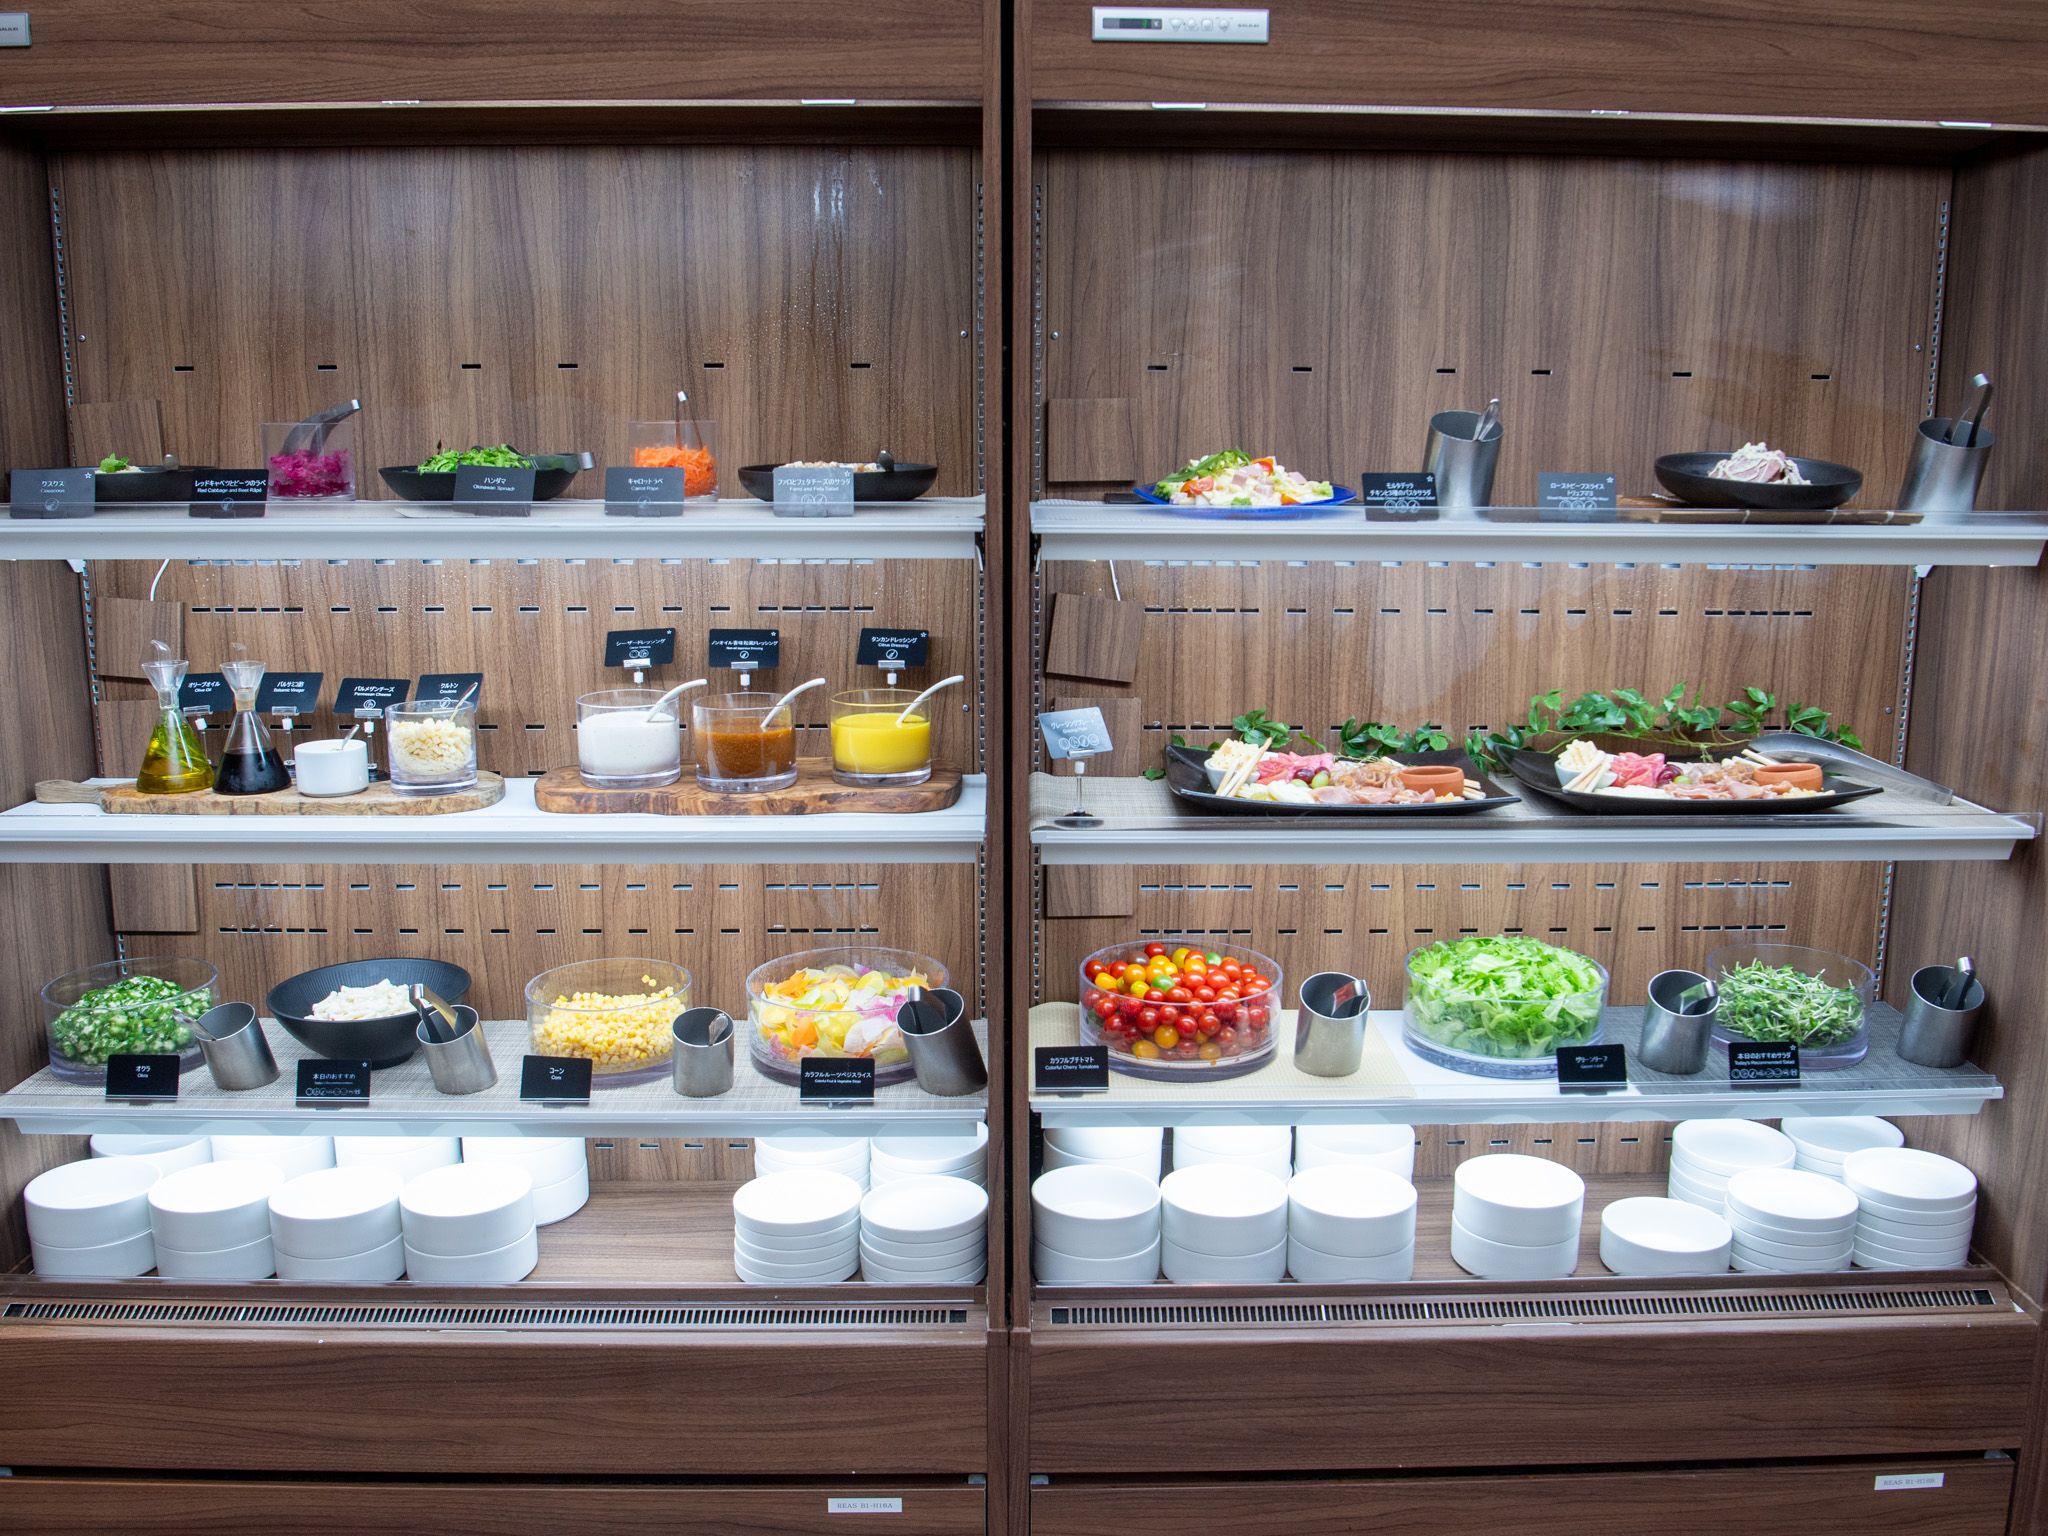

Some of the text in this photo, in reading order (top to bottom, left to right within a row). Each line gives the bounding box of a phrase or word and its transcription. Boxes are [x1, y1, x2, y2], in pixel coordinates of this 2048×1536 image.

[41, 480, 65, 488] クスクス
[484, 477, 507, 485] ハンダマ
[777, 478, 851, 486] ファロとフェタチーズのサラダ
[1550, 482, 1605, 490] ローストビーフスライス
[616, 638, 666, 647] シーザードレッシング
[871, 636, 918, 644] タンカンドレッシング
[353, 685, 396, 693] パルメザンチーズ
[1575, 1055, 1608, 1064] グリーンリーフ
[1737, 1051, 1792, 1060] 本日のおすすめサラダ
[1050, 1056, 1095, 1065] カラフルプチトマト
[135, 1065, 151, 1073] オクラ
[549, 1067, 565, 1075] コーン
